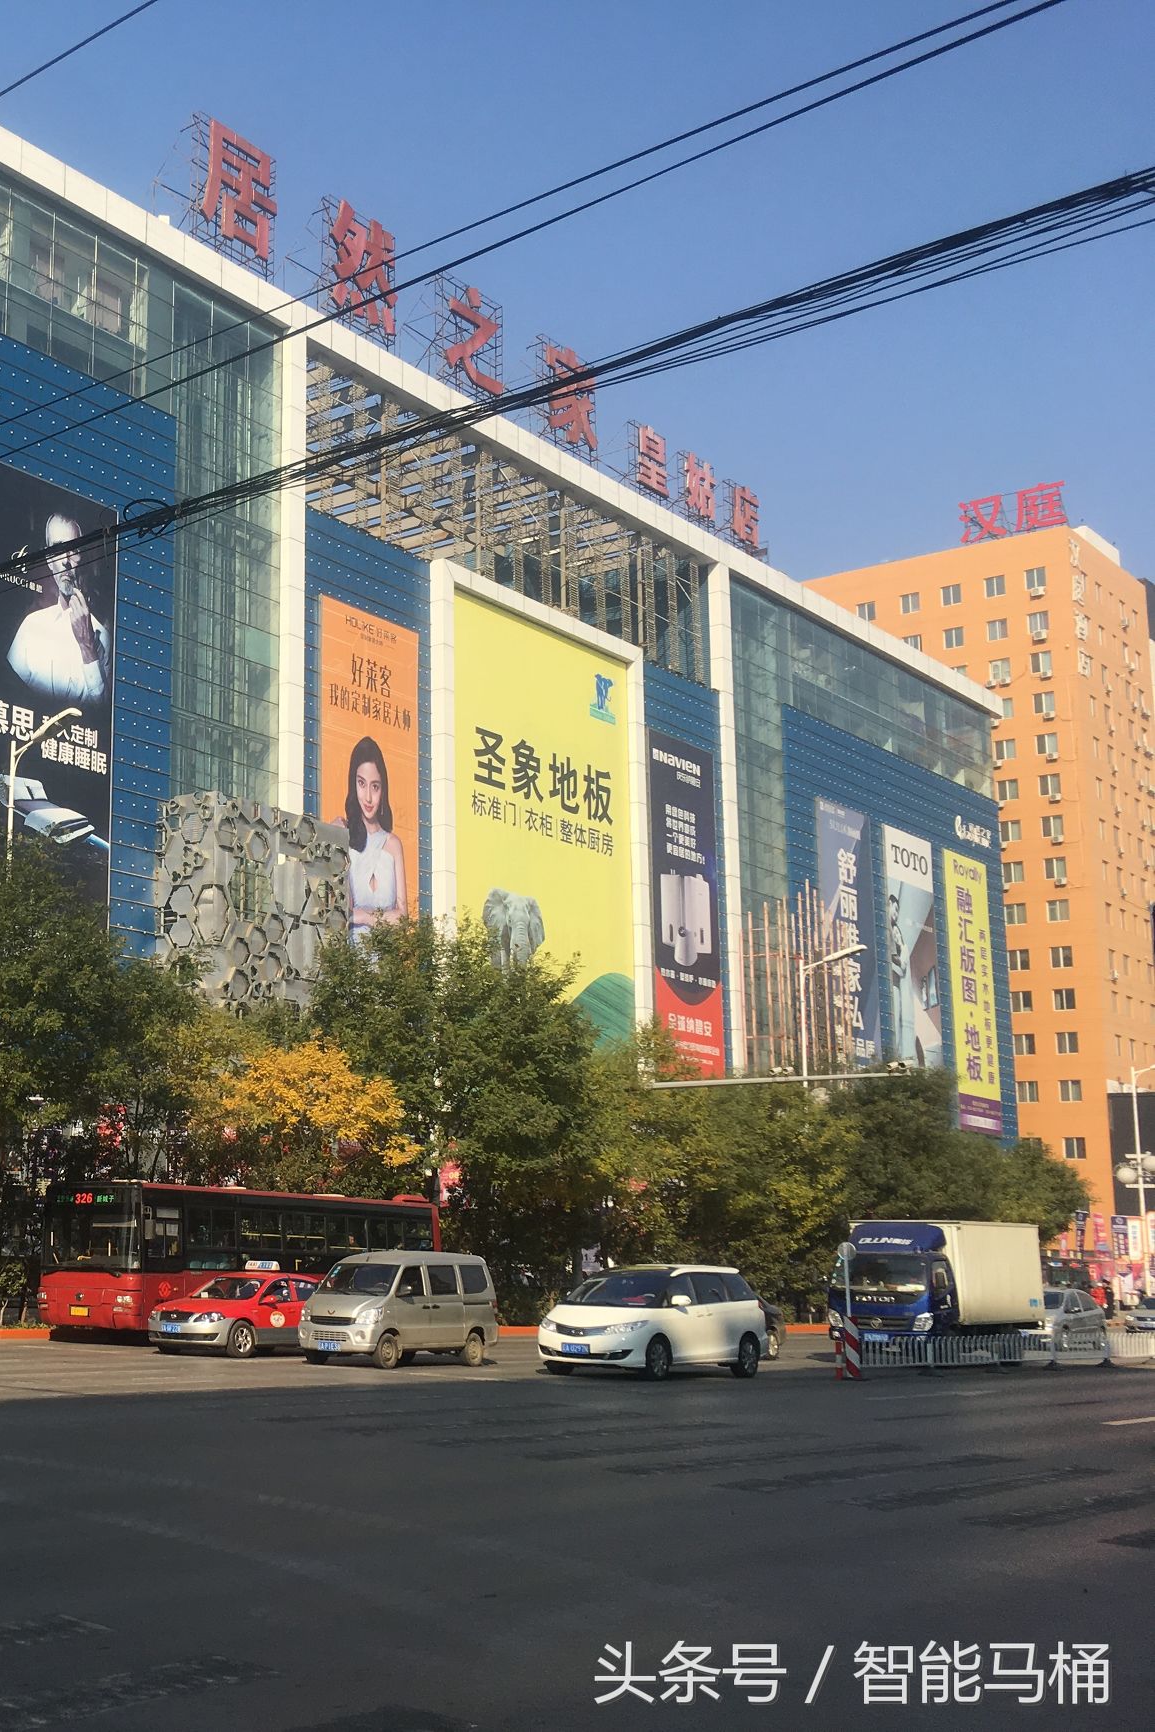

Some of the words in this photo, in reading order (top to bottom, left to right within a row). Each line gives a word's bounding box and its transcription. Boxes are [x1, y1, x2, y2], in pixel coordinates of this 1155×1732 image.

[198, 118, 599, 452] 居然之家
[636, 424, 760, 549] 皇姑店
[958, 480, 1068, 544] 汉庭
[351, 652, 392, 699] 好莱客
[329, 682, 412, 733] 我的定制家居大师
[40, 737, 107, 776] 健康睡眠
[473, 726, 614, 826] 圣象地板
[471, 789, 519, 827] 标准门
[524, 807, 554, 839] 衣柜
[560, 819, 614, 858] 整体厨房
[891, 844, 928, 876] TOTO
[75, 1193, 93, 1204] 326
